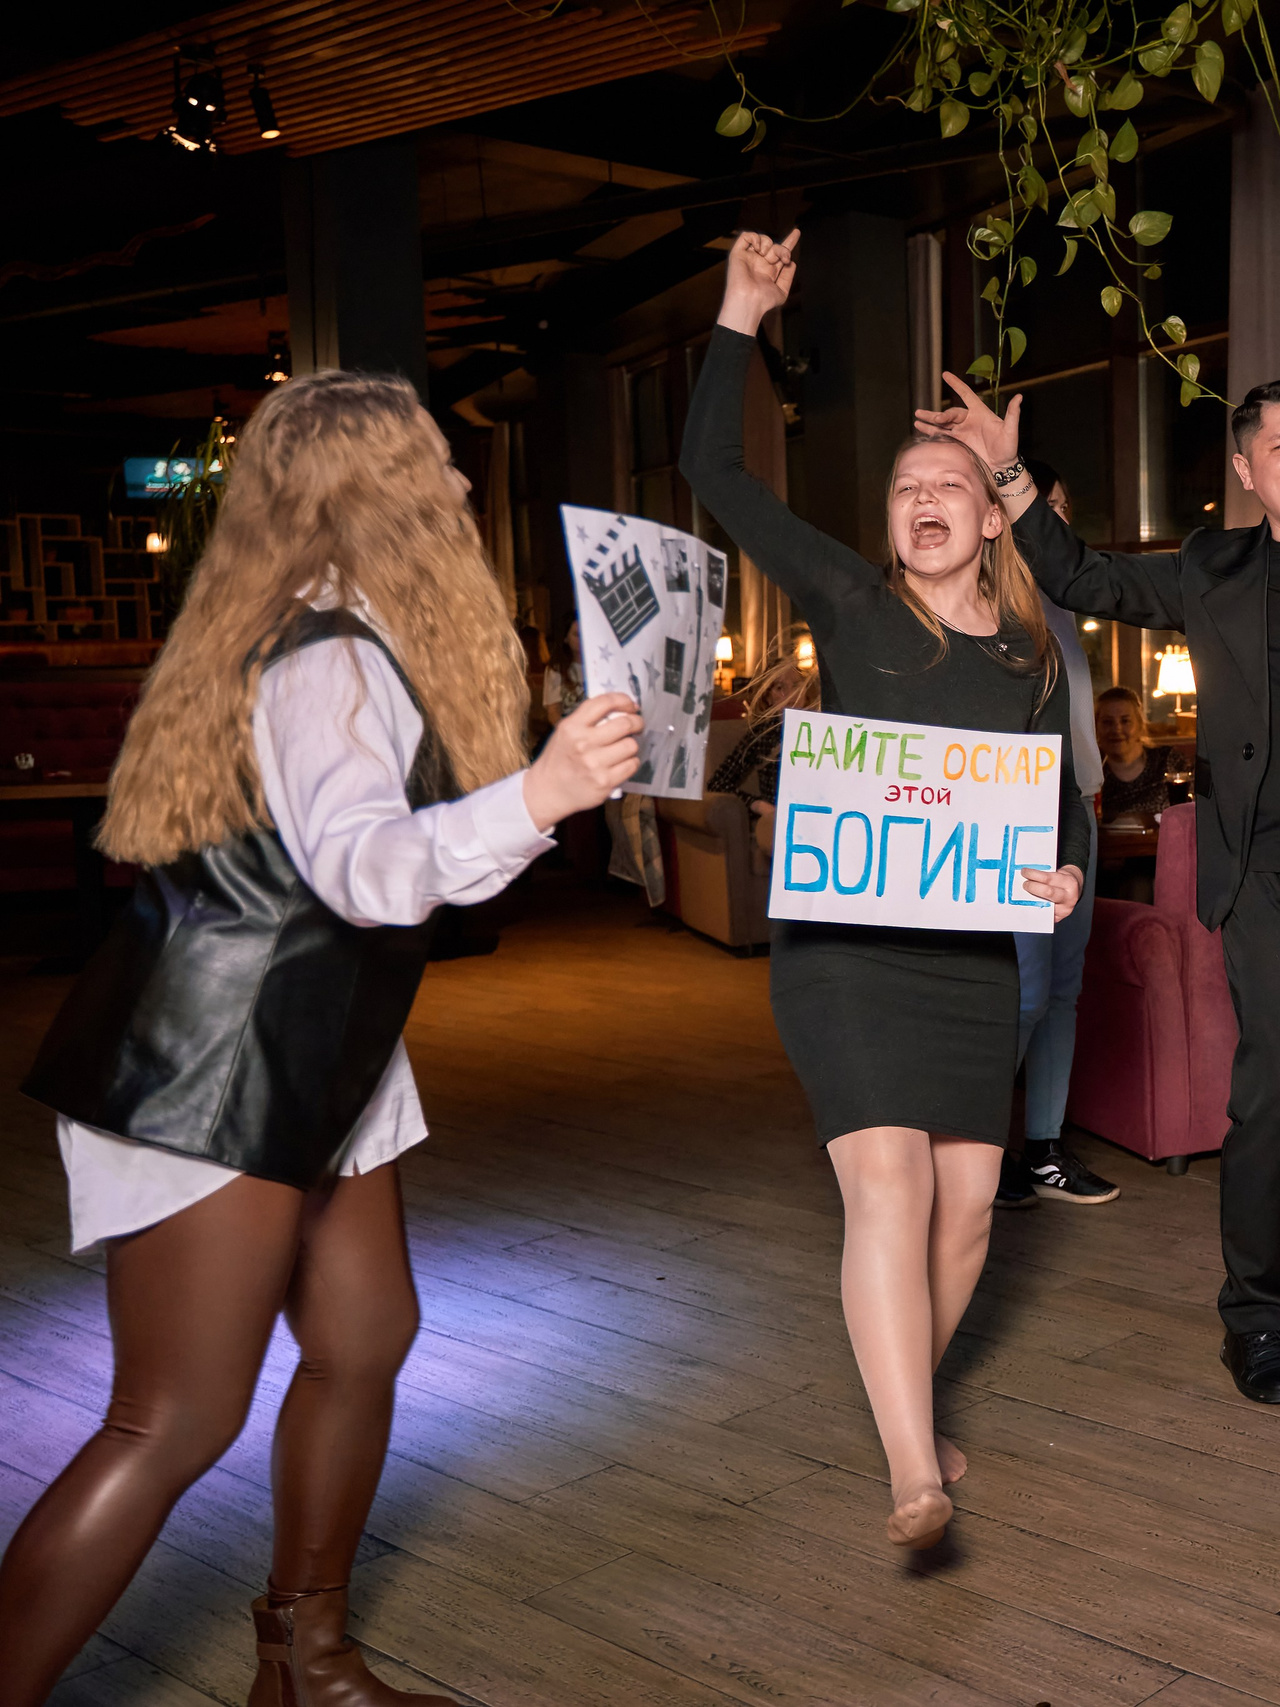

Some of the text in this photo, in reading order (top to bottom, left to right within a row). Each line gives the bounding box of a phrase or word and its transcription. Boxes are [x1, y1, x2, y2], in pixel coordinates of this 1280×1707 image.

[790, 721, 1056, 785] ДАЙТЕ ОСКАР
[784, 803, 1054, 909] БОГИНЕ
